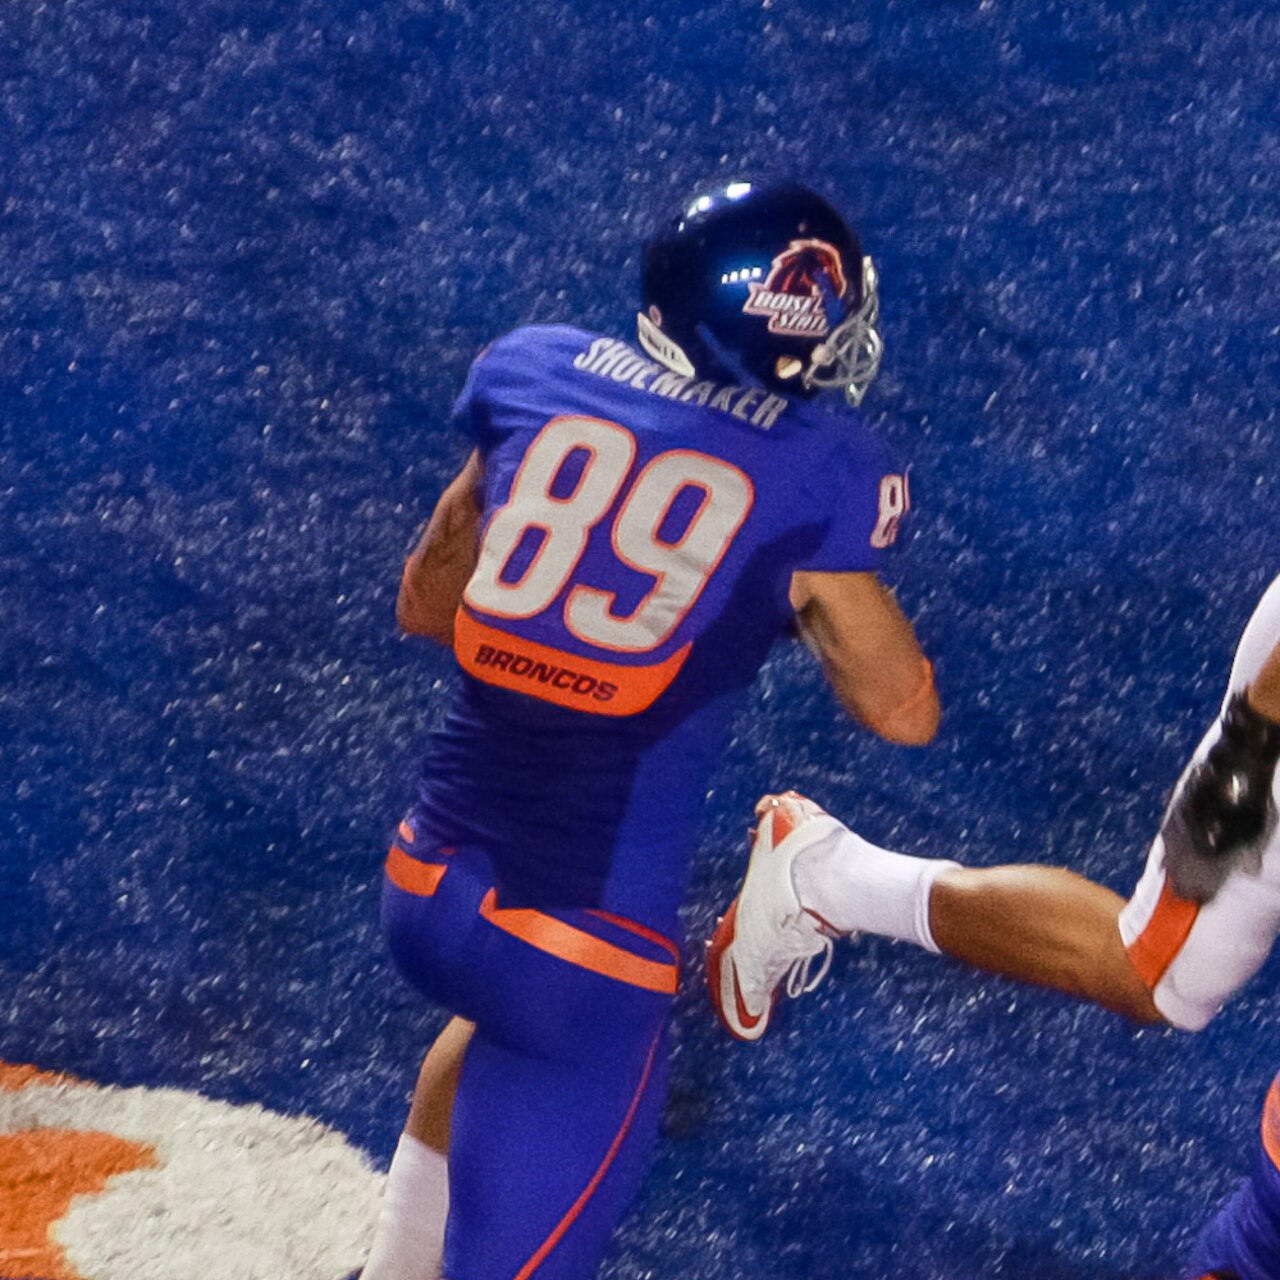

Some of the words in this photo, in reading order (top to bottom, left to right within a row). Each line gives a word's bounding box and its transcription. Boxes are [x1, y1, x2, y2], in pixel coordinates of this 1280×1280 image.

[573, 337, 789, 430] SHOEMAKER
[463, 414, 755, 654] 89
[869, 470, 911, 550] 8
[475, 644, 619, 702] BRONCOS
